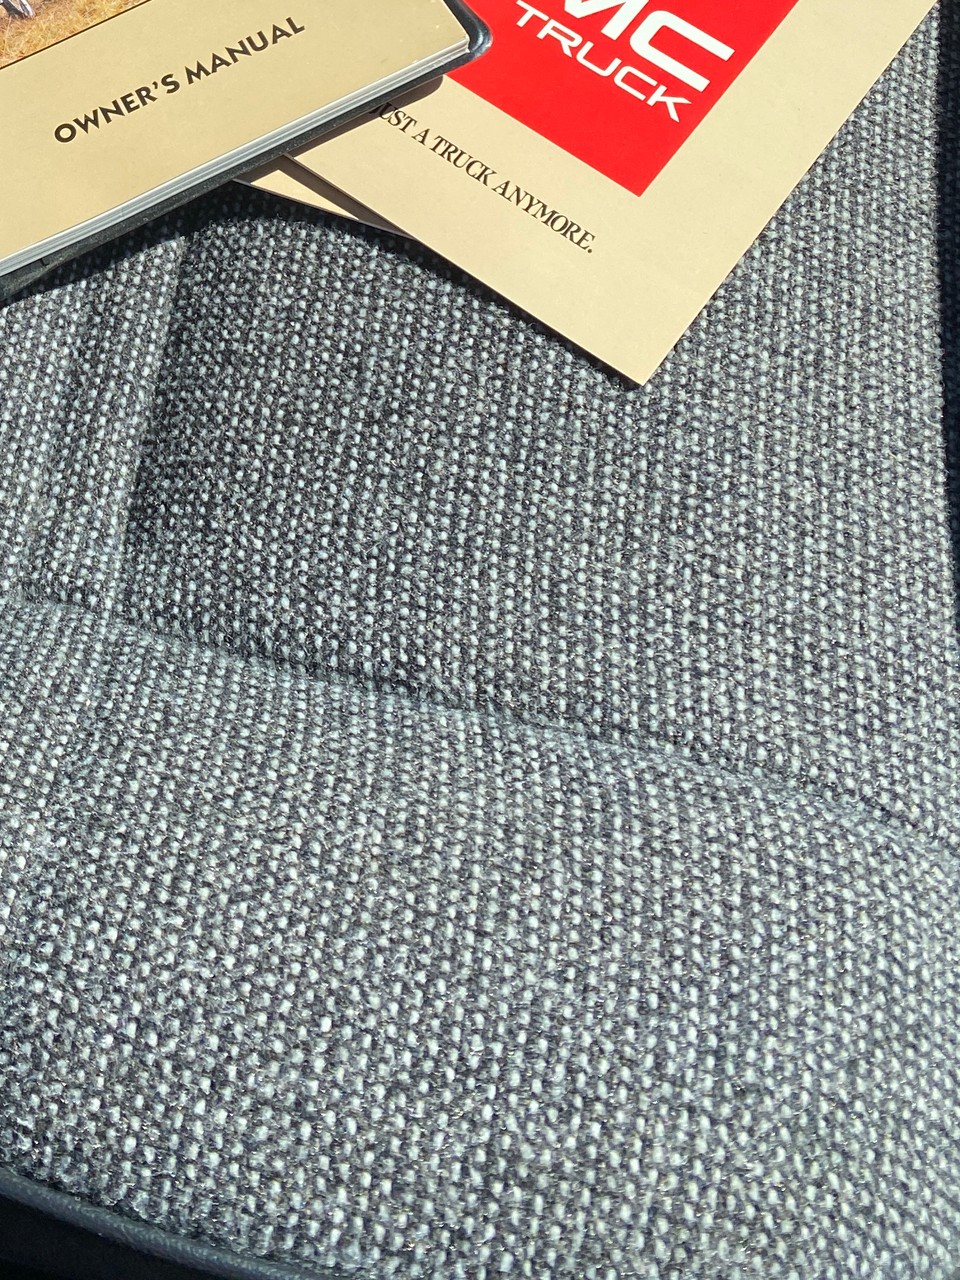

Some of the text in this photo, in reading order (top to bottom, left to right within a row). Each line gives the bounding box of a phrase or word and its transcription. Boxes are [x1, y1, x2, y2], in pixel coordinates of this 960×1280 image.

[54, 16, 305, 143] OWNER'S MANUAL
[515, 0, 693, 123] TRUCK
[369, 102, 596, 253] UST A TRUCK ANYMORE.
